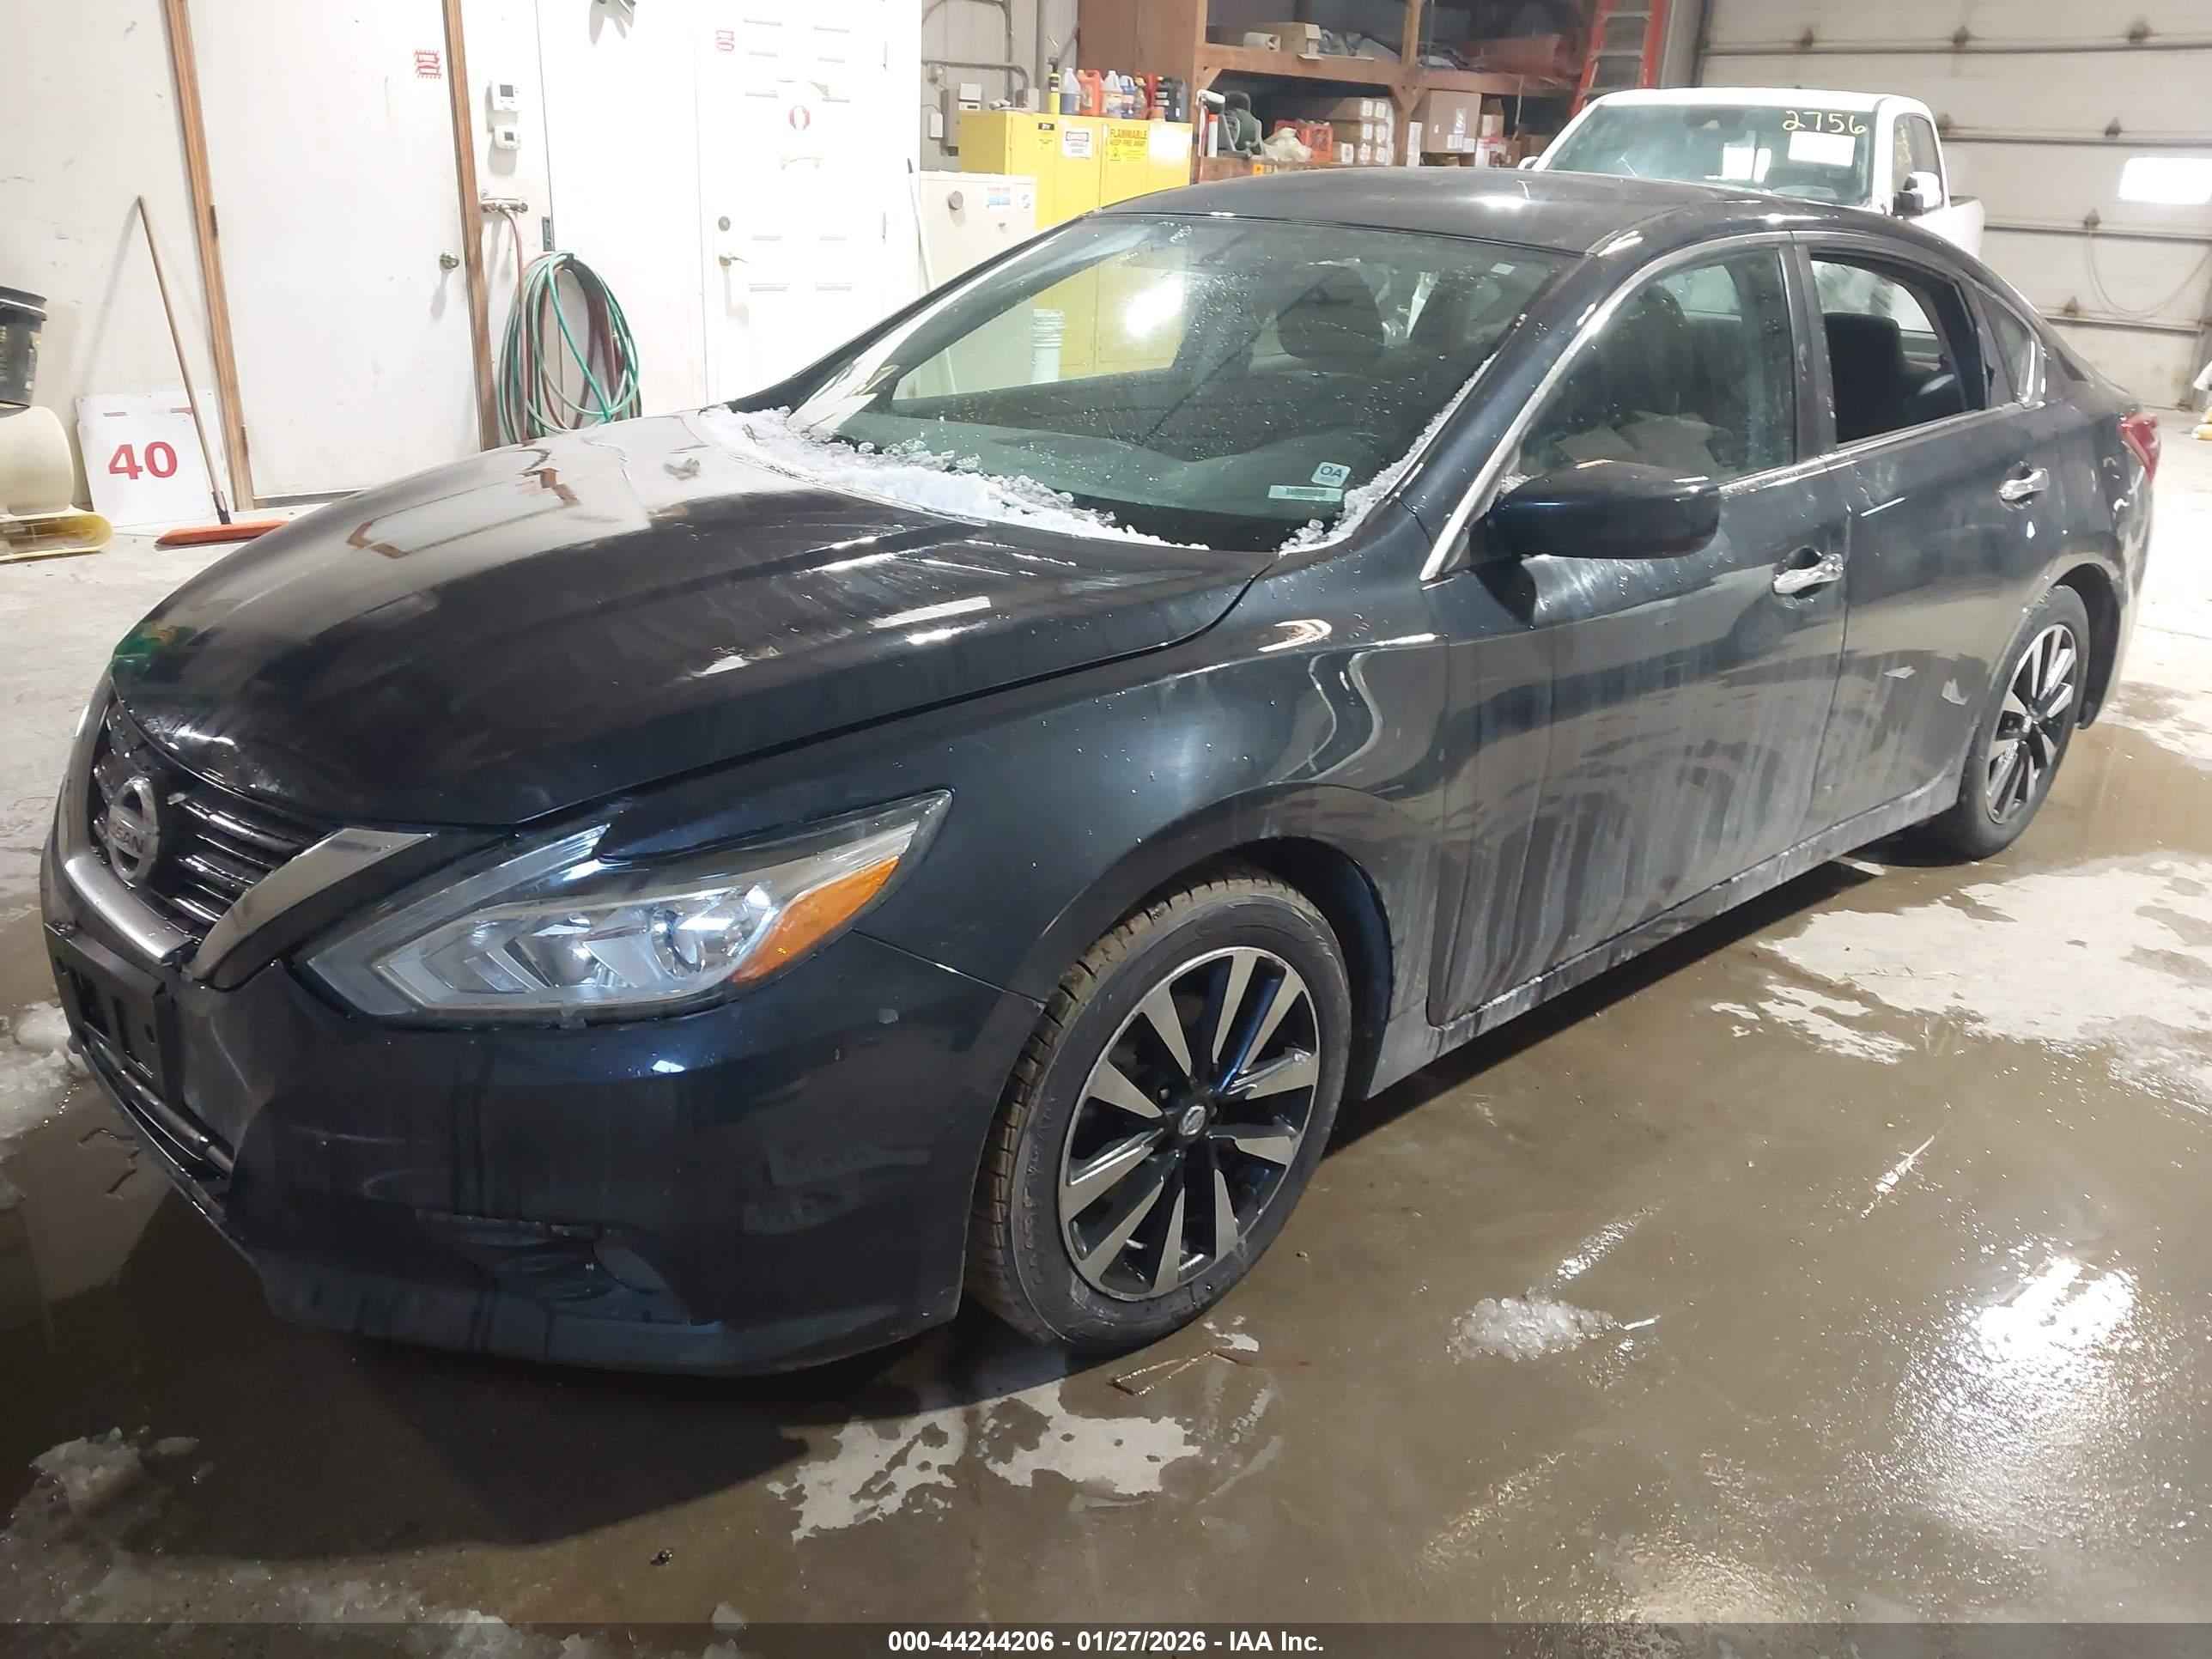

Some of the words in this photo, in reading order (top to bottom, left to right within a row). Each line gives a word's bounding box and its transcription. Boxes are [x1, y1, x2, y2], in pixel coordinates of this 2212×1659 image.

[1109, 128, 1148, 140] FLAMMABLE
[1782, 110, 1868, 135] 2756
[108, 441, 178, 480] 40
